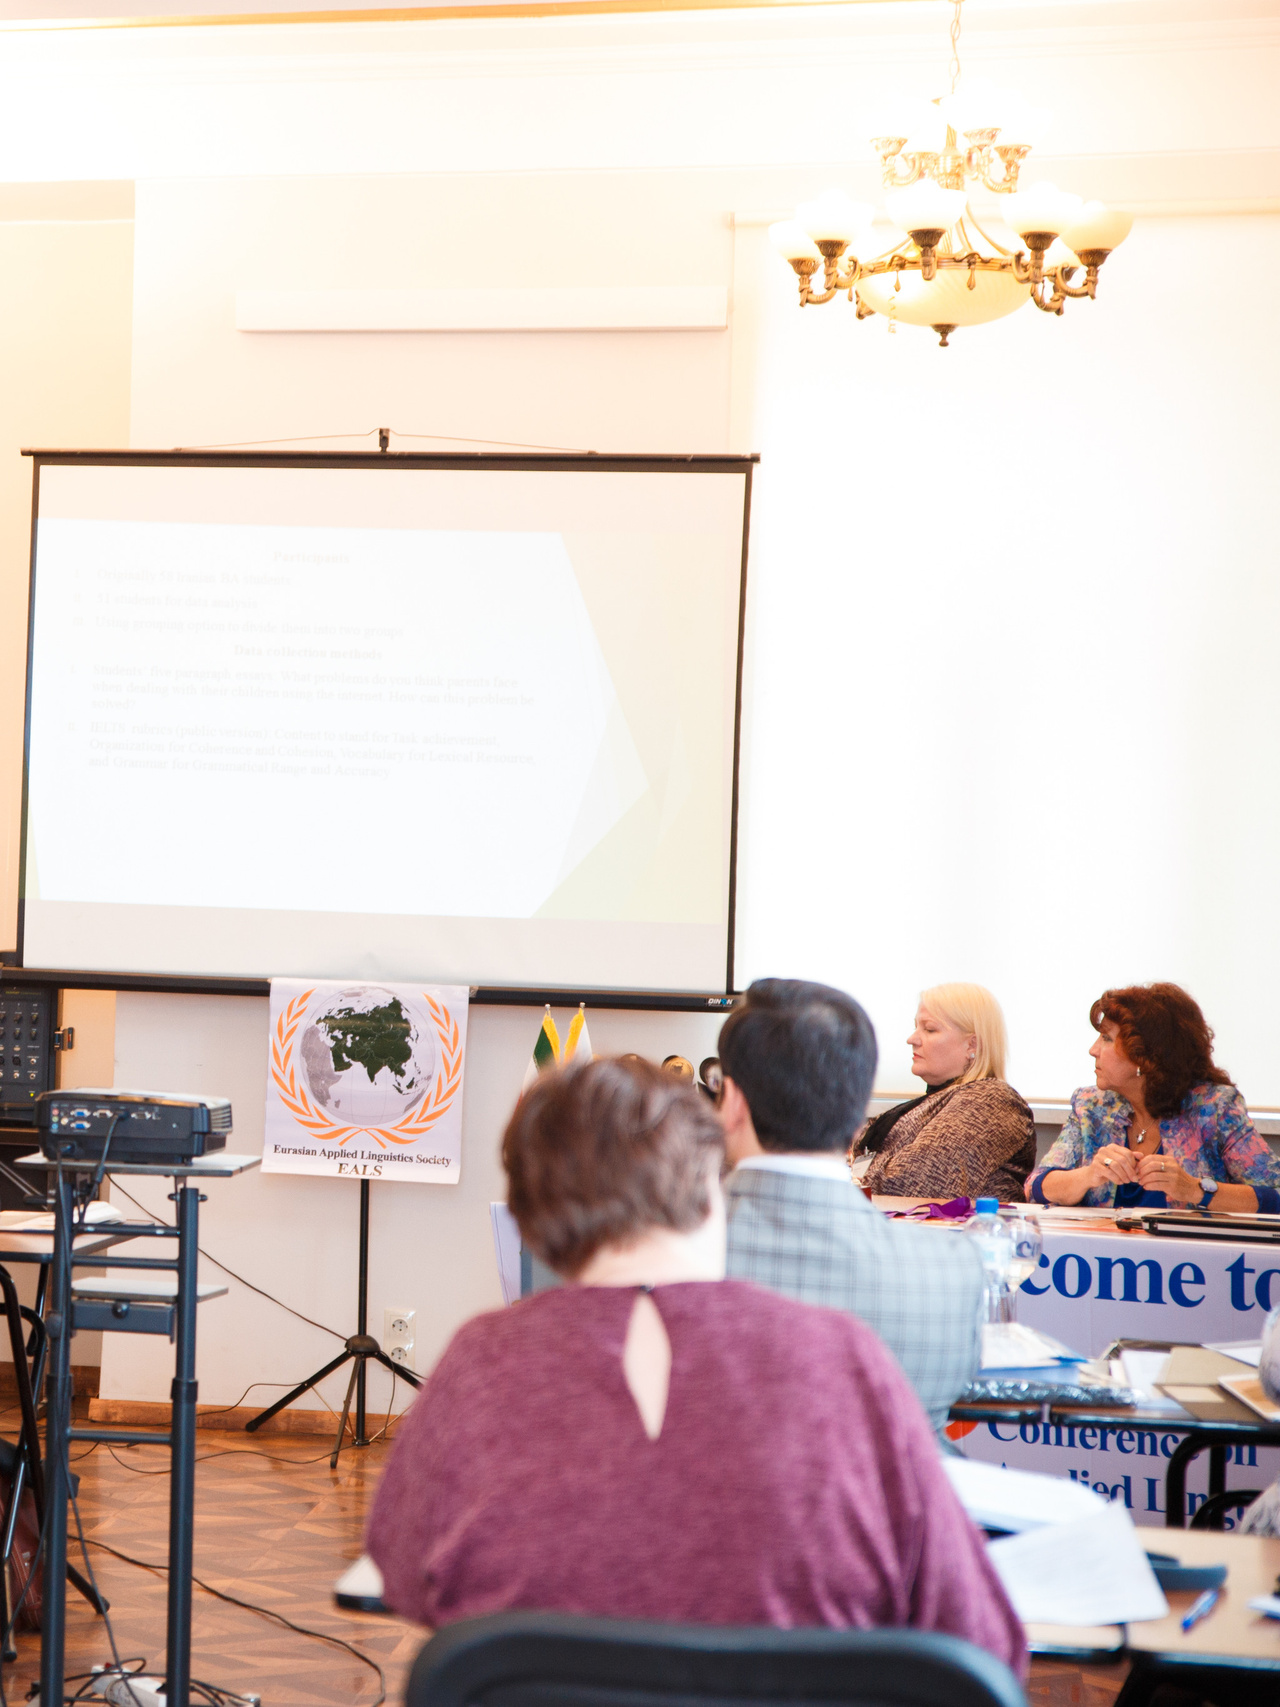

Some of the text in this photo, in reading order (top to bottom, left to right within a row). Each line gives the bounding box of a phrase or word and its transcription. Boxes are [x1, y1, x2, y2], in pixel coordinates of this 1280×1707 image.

[97, 569, 156, 582] Originally
[220, 573, 240, 584] BA
[243, 574, 291, 586] students
[114, 594, 161, 606] students
[165, 596, 181, 606] for
[185, 597, 209, 608] data
[211, 599, 258, 611] analysis
[95, 616, 129, 630] Using
[133, 618, 184, 633] grouping
[187, 619, 225, 634] option
[228, 621, 239, 632] to
[242, 621, 277, 634] divide
[282, 623, 311, 634] them
[314, 624, 336, 635] into
[339, 626, 360, 636] two
[364, 627, 404, 640] groups
[234, 644, 382, 660] Data collection methods
[150, 665, 171, 677] five
[175, 667, 231, 682] paragraph
[281, 671, 310, 683] What
[314, 672, 369, 686] problems
[372, 674, 387, 685] do
[390, 676, 410, 688] you
[415, 675, 443, 686] think
[447, 677, 490, 689] parents
[493, 677, 518, 688] face
[92, 682, 122, 693] when
[126, 683, 169, 697] dealing
[172, 684, 197, 695] with
[201, 685, 228, 696] their
[231, 686, 279, 698] children
[282, 689, 313, 701] using
[316, 689, 334, 700] the
[389, 692, 416, 703] How
[420, 694, 440, 703] can
[443, 693, 465, 704] this
[468, 694, 517, 707] problem
[520, 696, 534, 706] be
[90, 722, 125, 733] IELTS
[131, 724, 173, 736] rubrics
[275, 729, 321, 740] Content
[324, 731, 336, 741] to
[339, 731, 368, 742] stand
[372, 732, 388, 743] for
[392, 732, 418, 744] Task
[89, 739, 165, 753] Organization
[169, 741, 186, 752] for
[189, 743, 252, 755] Coherence
[255, 745, 275, 756] and
[340, 748, 404, 762] Vocabulary
[408, 749, 426, 760] for
[429, 750, 473, 763] Lexical
[89, 756, 390, 780] and Grammar for Grammatical Range and Accuracy
[273, 1144, 452, 1168] Eurasian Applied Linguistics Society
[337, 1163, 383, 1177] EALS
[1020, 1253, 1206, 1308] come
[987, 1421, 1200, 1461] Conferenc
